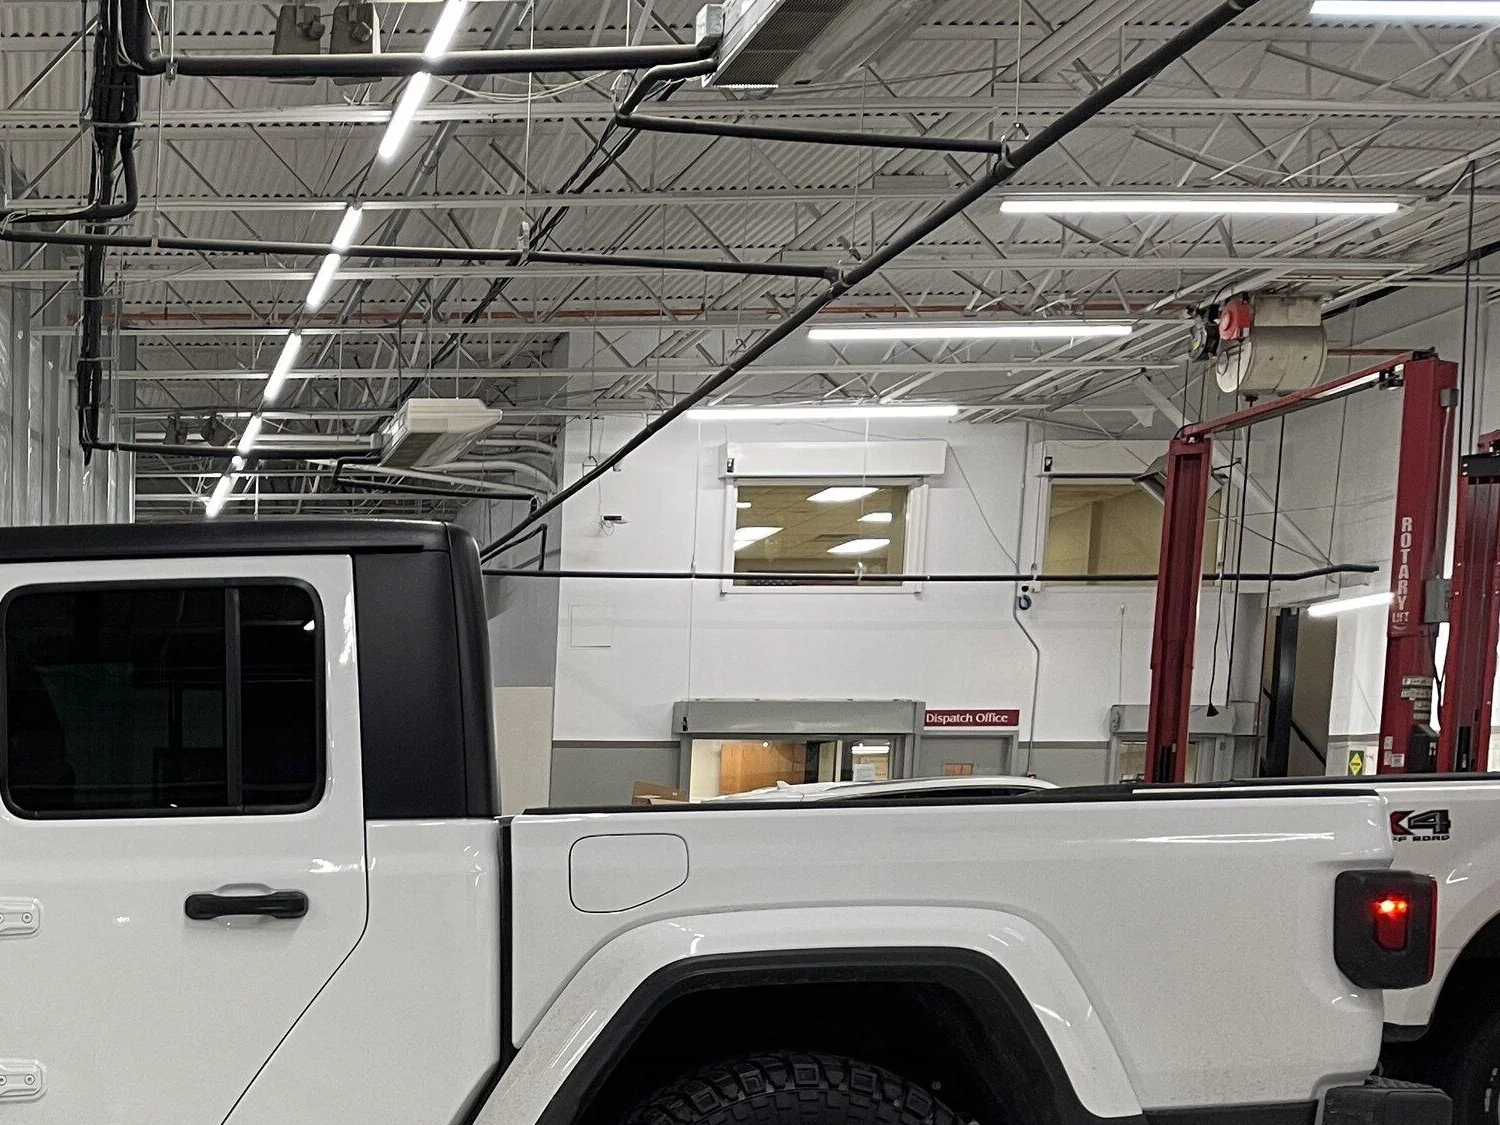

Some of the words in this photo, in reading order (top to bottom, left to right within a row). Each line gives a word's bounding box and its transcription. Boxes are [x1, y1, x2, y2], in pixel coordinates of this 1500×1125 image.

[1396, 516, 1413, 611] ROTARY
[926, 713, 973, 725] Dispatch
[975, 712, 1009, 723] Office
